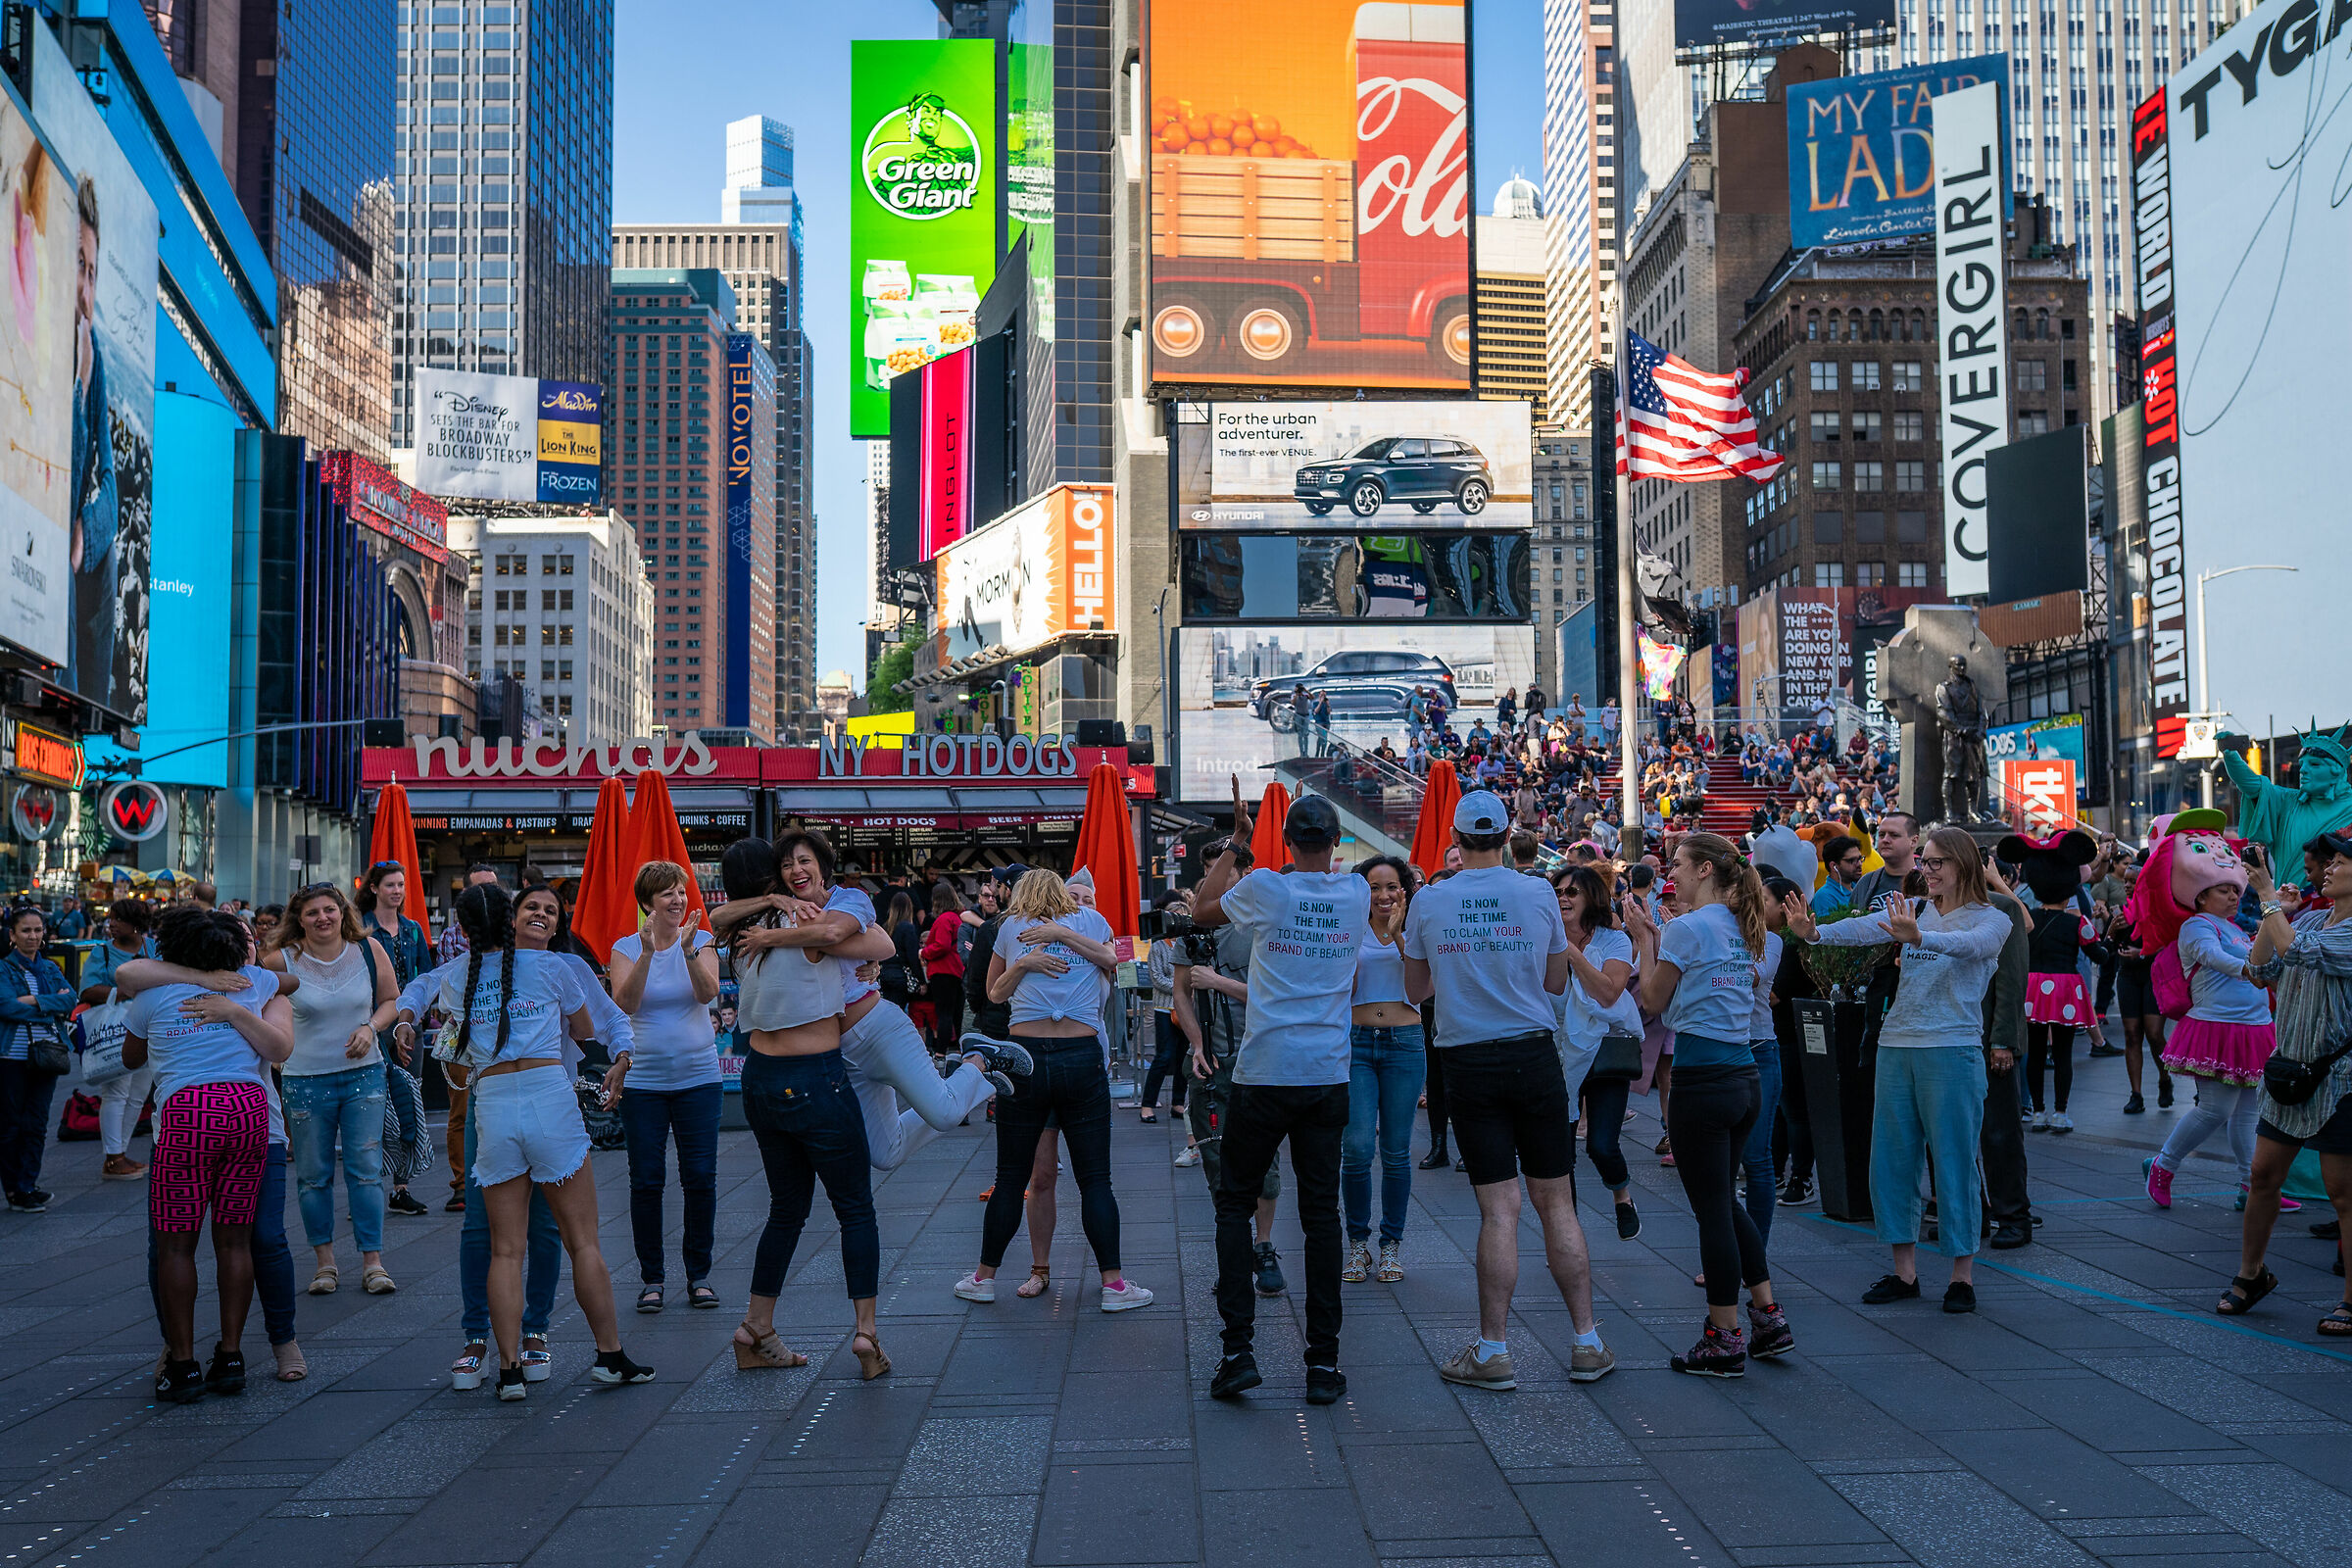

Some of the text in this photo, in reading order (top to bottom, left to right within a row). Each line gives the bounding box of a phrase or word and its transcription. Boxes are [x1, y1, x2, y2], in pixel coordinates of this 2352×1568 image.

[1757, 16, 1793, 26] THEATRE
[1807, 89, 1876, 138] MY
[877, 156, 974, 182] Green
[1806, 124, 1934, 212] LAD
[889, 182, 978, 209] Giant
[1824, 223, 1878, 240] Lincoln
[1881, 220, 1921, 233] Center
[2135, 142, 2173, 312] WORLD
[1942, 145, 1999, 562] COVERGIRL
[542, 390, 598, 413] Aladdin
[2143, 355, 2178, 448] HOT
[430, 415, 520, 432] SETS THE BAR FOR
[728, 351, 752, 486] NOVOTEL
[1218, 413, 1317, 424] For the urban
[441, 428, 511, 447] BROADWAY
[1218, 428, 1303, 440] adventurer.
[946, 413, 956, 532] INGLOT
[540, 470, 597, 492] FROZEN
[1213, 511, 1264, 520] HYUNDAI
[1073, 491, 1103, 624] HELLO!
[976, 559, 1030, 610] MORMN
[2145, 455, 2187, 709] CHOCOLATE
[1784, 602, 1824, 614] WHAT
[1784, 616, 1807, 627] THE
[1785, 629, 1810, 641] ARE
[1786, 643, 1832, 655] DOING
[1786, 656, 1820, 667] NEW
[1787, 669, 1815, 681] AND
[1787, 682, 1828, 695] IN THE
[1022, 674, 1033, 725] OLIVE
[413, 716, 718, 777] nuchas
[819, 732, 1078, 777] NY HOTDOGS
[114, 797, 157, 828] W
[451, 817, 503, 829] EMPANADAS
[506, 818, 514, 828] &
[515, 817, 558, 828] PASTRIES
[679, 814, 710, 825] DRINKS
[716, 814, 747, 826] COFFEE
[897, 817, 937, 826] DOGS
[1299, 902, 1334, 913] IS NOW
[1461, 898, 1498, 908] IS NOW
[1295, 915, 1340, 928] THE TIME
[1458, 911, 1507, 923] THE TIME
[1278, 928, 1349, 944] TO CLAIM YOUR
[1443, 926, 1522, 939] TO CLAIM YOUR
[1268, 942, 1354, 958] BRAND OF BEAUTY?
[1438, 941, 1534, 955] BRAND OF BEAUTY?
[1907, 953, 1938, 961] MAGIC
[1712, 976, 1736, 988] BRAND
[1736, 976, 1743, 987] OF
[472, 996, 491, 1008] THE
[508, 1001, 536, 1010] YOUR
[167, 1026, 204, 1038] BRAND
